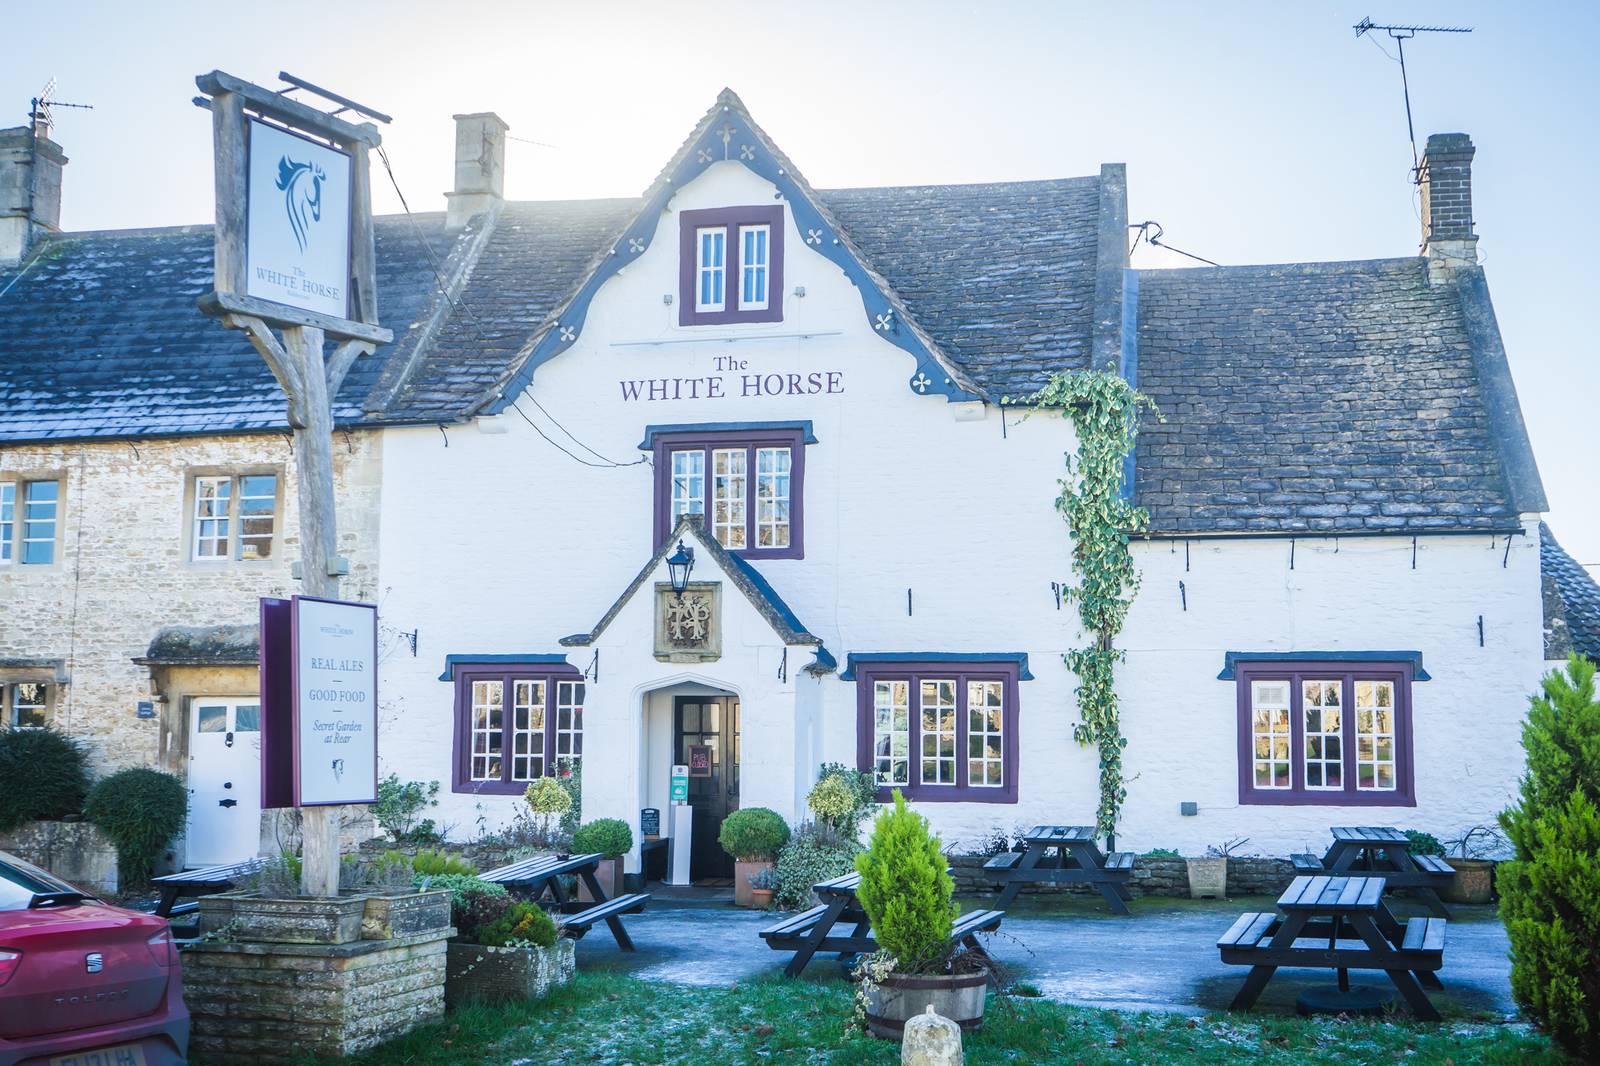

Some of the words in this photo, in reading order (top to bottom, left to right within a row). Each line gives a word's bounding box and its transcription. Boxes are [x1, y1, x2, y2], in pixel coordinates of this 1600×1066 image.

[292, 266, 306, 277] The
[256, 266, 299, 290] WHITE
[303, 279, 340, 300] HORSE
[713, 356, 748, 372] The
[619, 376, 725, 401] WHITE
[741, 371, 845, 397] HORSE
[311, 657, 338, 671] REAL
[338, 659, 364, 672] ALES
[309, 689, 337, 702] GOOD
[339, 690, 366, 703] FOOD
[312, 719, 335, 731] Secret
[336, 720, 362, 732] Garden
[324, 734, 333, 744] at
[333, 732, 352, 744] Rear
